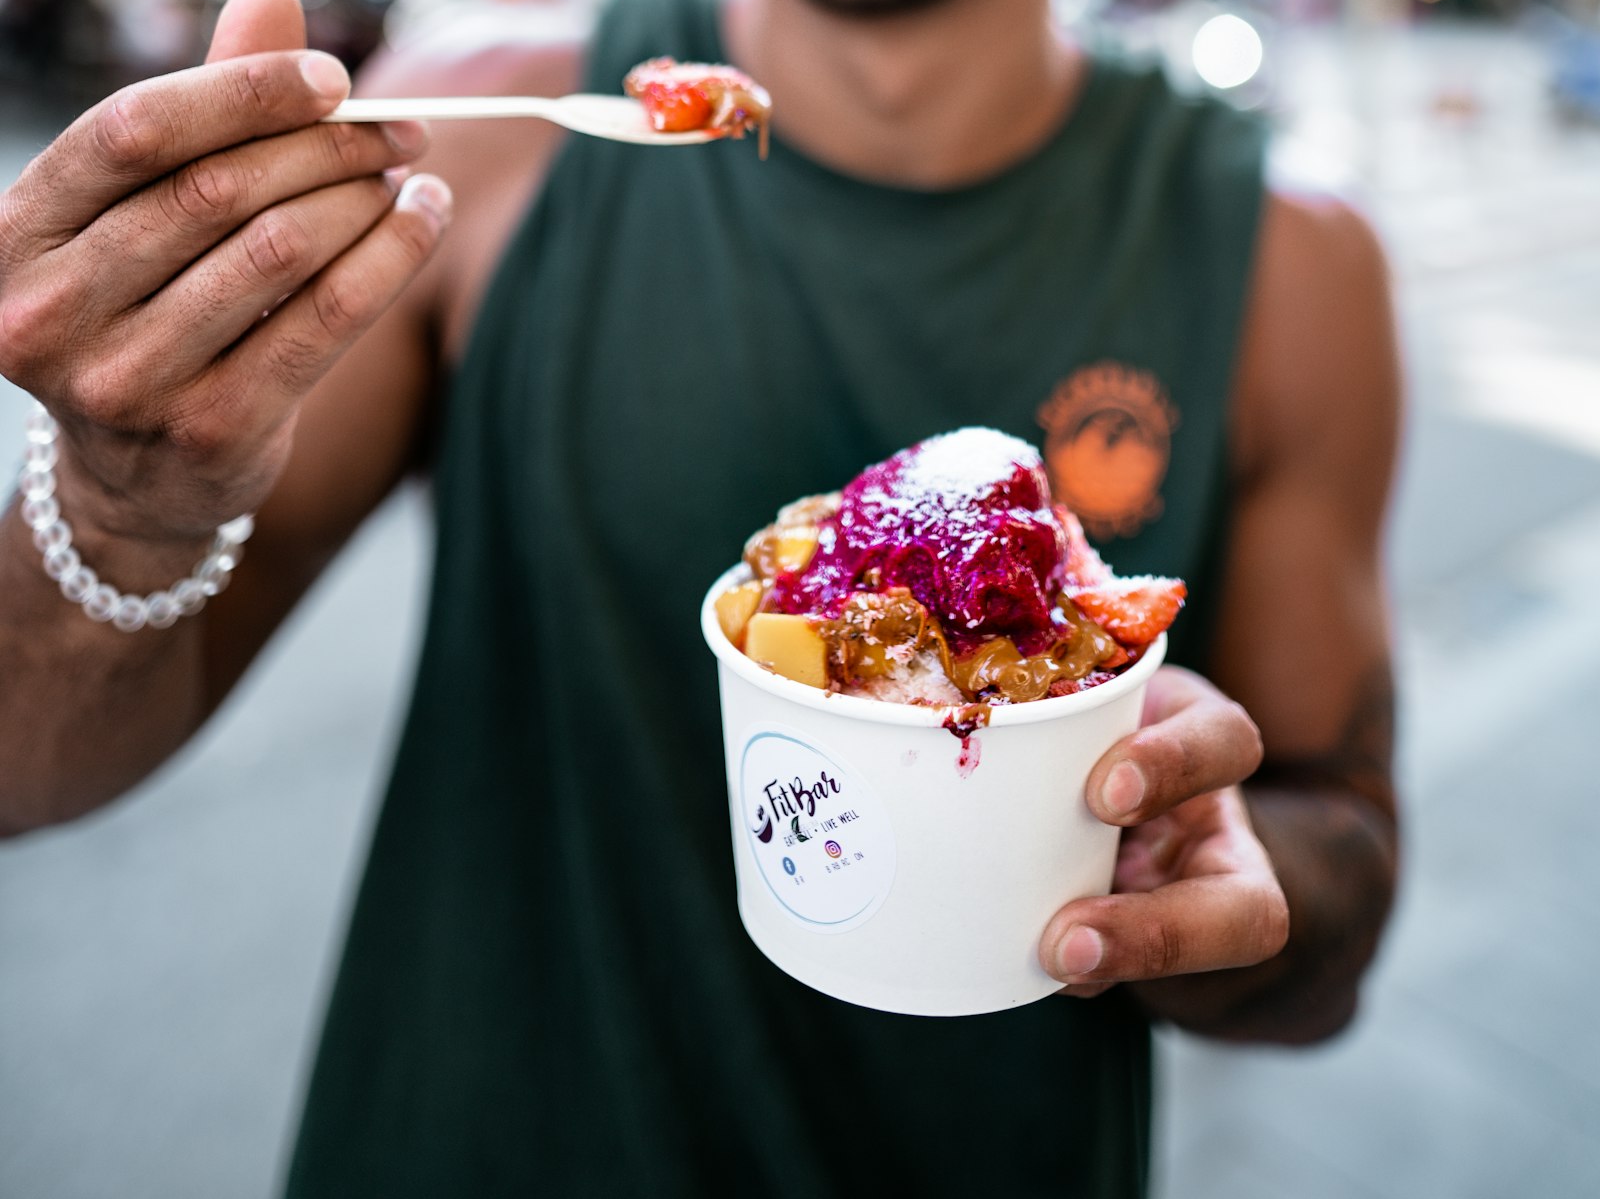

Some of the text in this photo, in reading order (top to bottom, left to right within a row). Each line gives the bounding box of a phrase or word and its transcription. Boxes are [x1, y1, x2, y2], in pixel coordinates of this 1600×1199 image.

[763, 771, 841, 823] FitBar
[820, 818, 838, 833] LIVE
[837, 809, 860, 824] WELL
